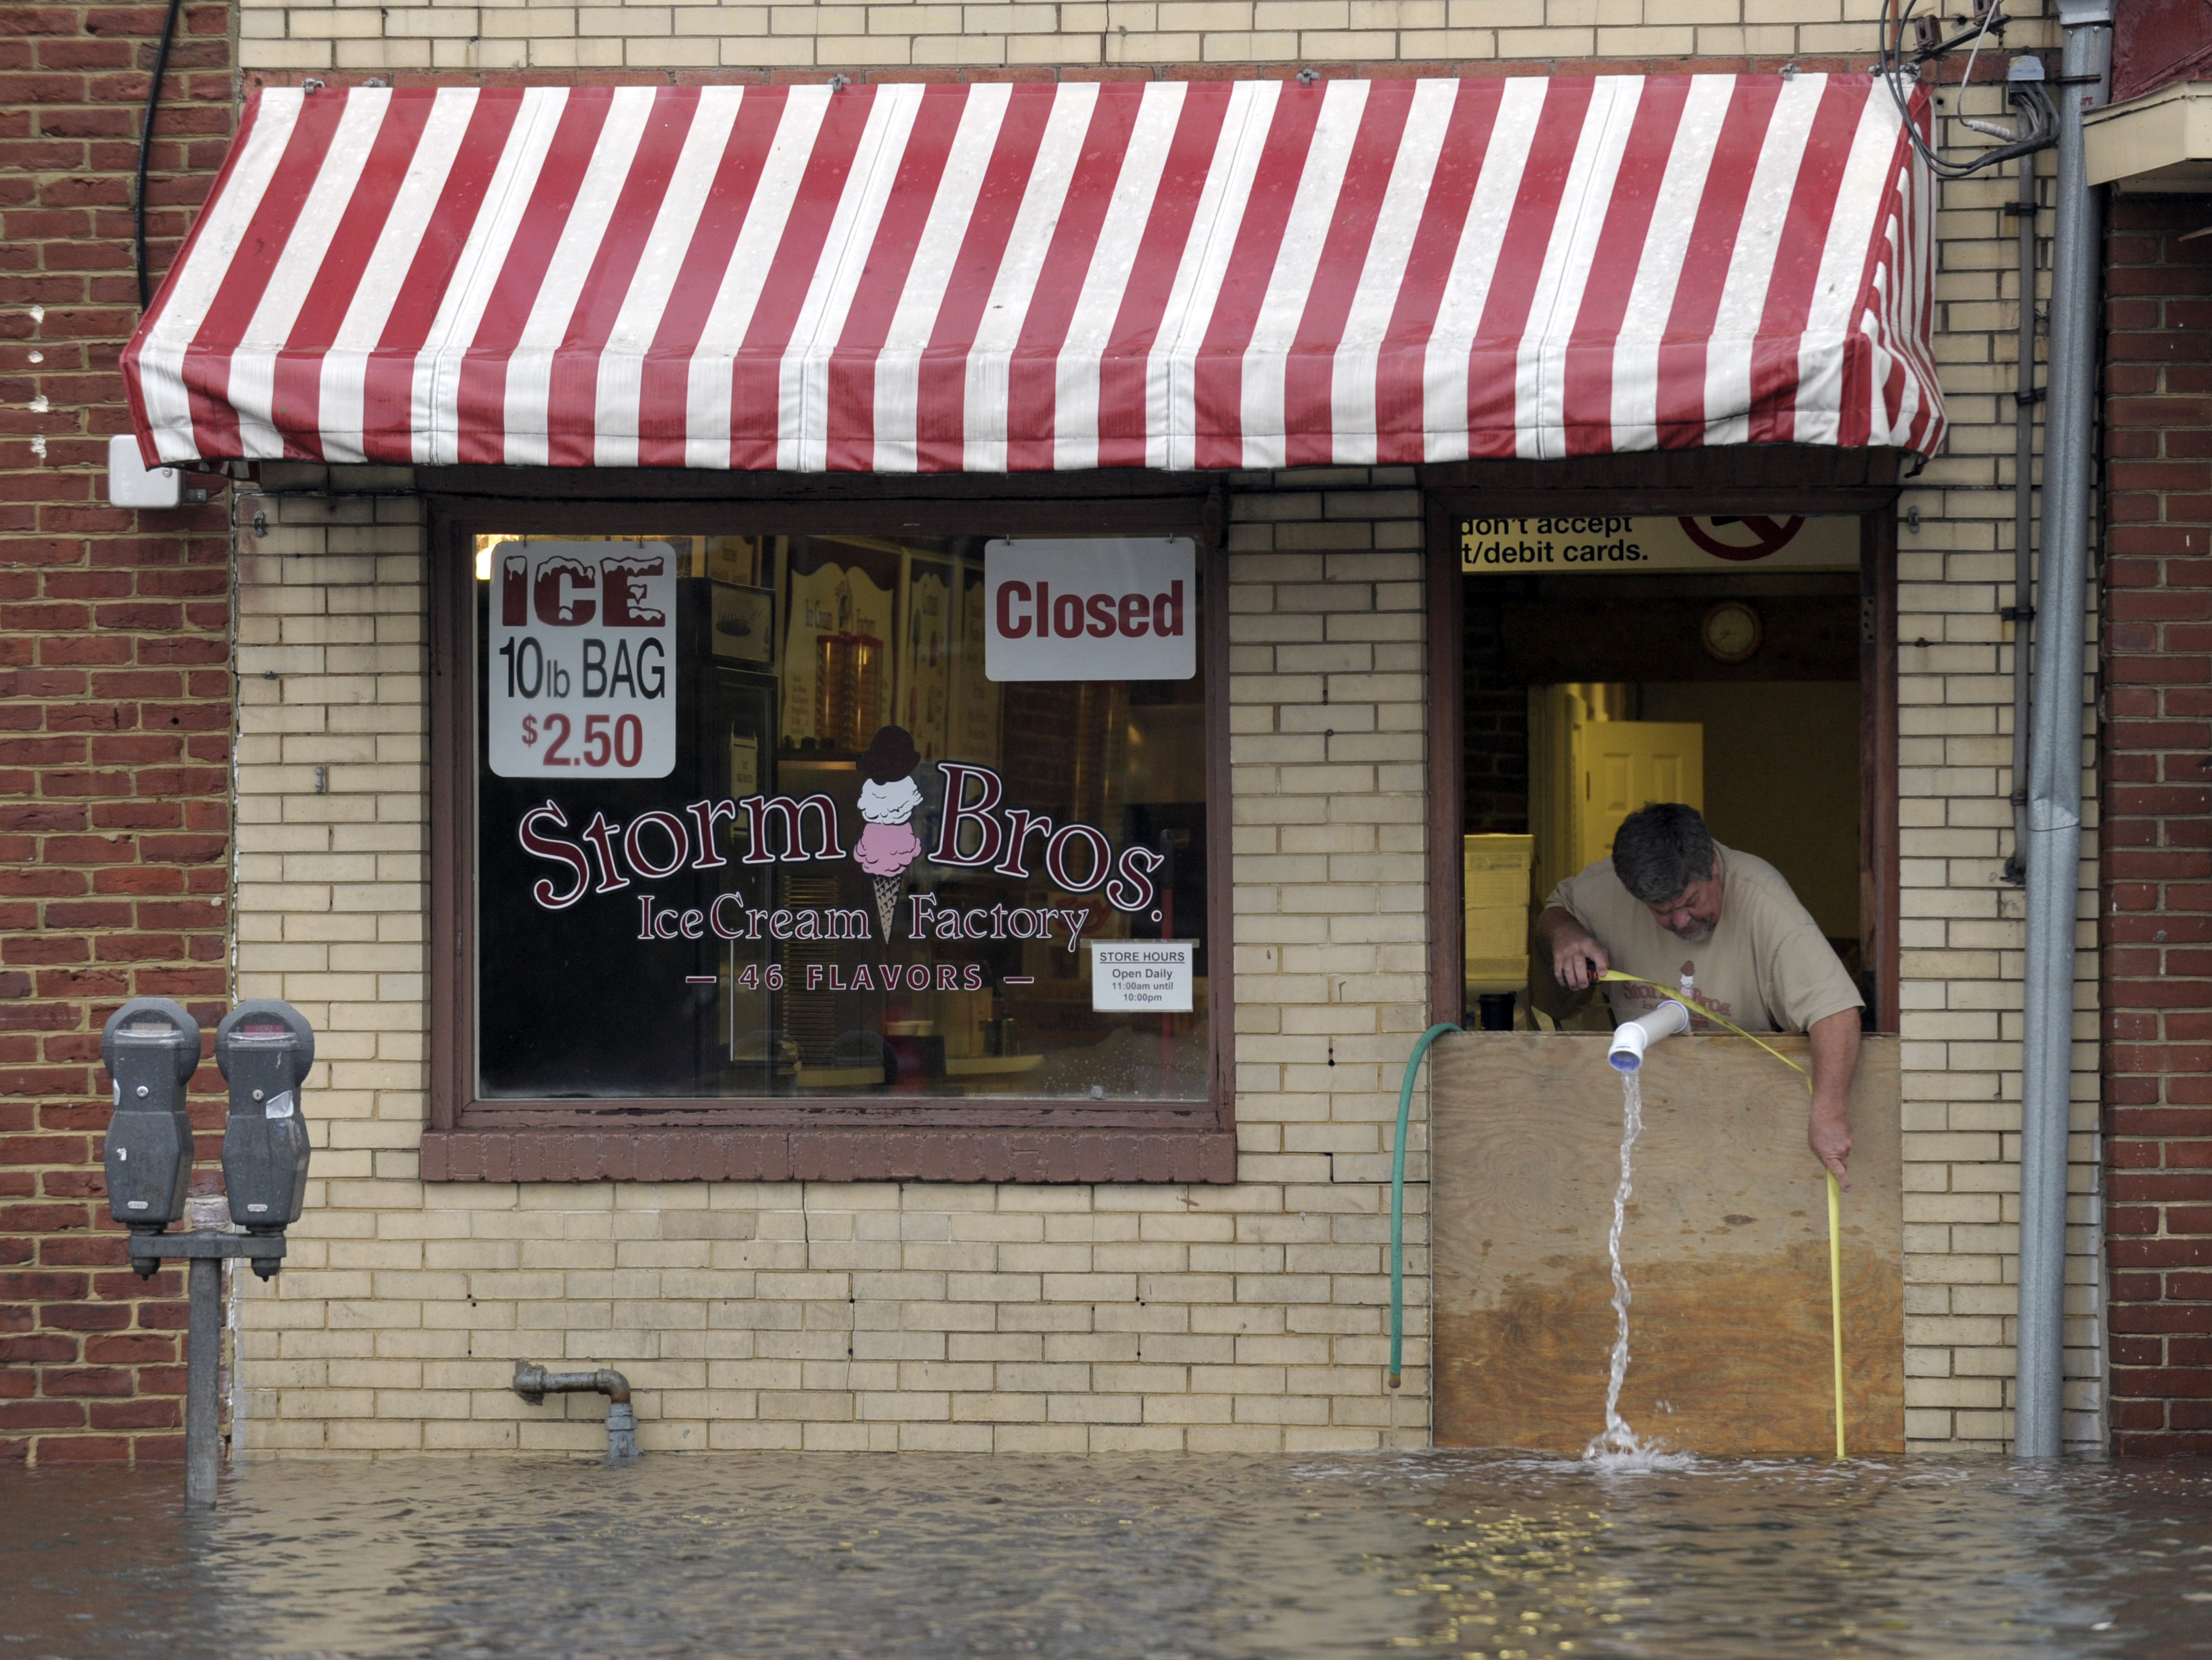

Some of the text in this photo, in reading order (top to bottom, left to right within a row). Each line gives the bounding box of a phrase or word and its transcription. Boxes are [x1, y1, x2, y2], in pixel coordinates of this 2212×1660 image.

[1536, 517, 1632, 538] accept
[1563, 539, 1648, 561] cards.
[502, 555, 666, 627] ICE
[996, 580, 1184, 639] Closed
[499, 636, 666, 700] 10lb BAG
[521, 713, 643, 767] $2.50
[518, 762, 1165, 922] Storm Bros.
[637, 895, 704, 940] Ice
[710, 891, 872, 940] Cream
[908, 892, 1090, 953] Factory
[1100, 952, 1185, 961] STORE HOURS
[738, 964, 983, 991] 46 FLAVORS
[1112, 968, 1172, 980] Open Daily
[1112, 982, 1174, 990] 11:00am until
[1124, 993, 1162, 1003] 10:00pm
[1623, 981, 1672, 999] Stor
